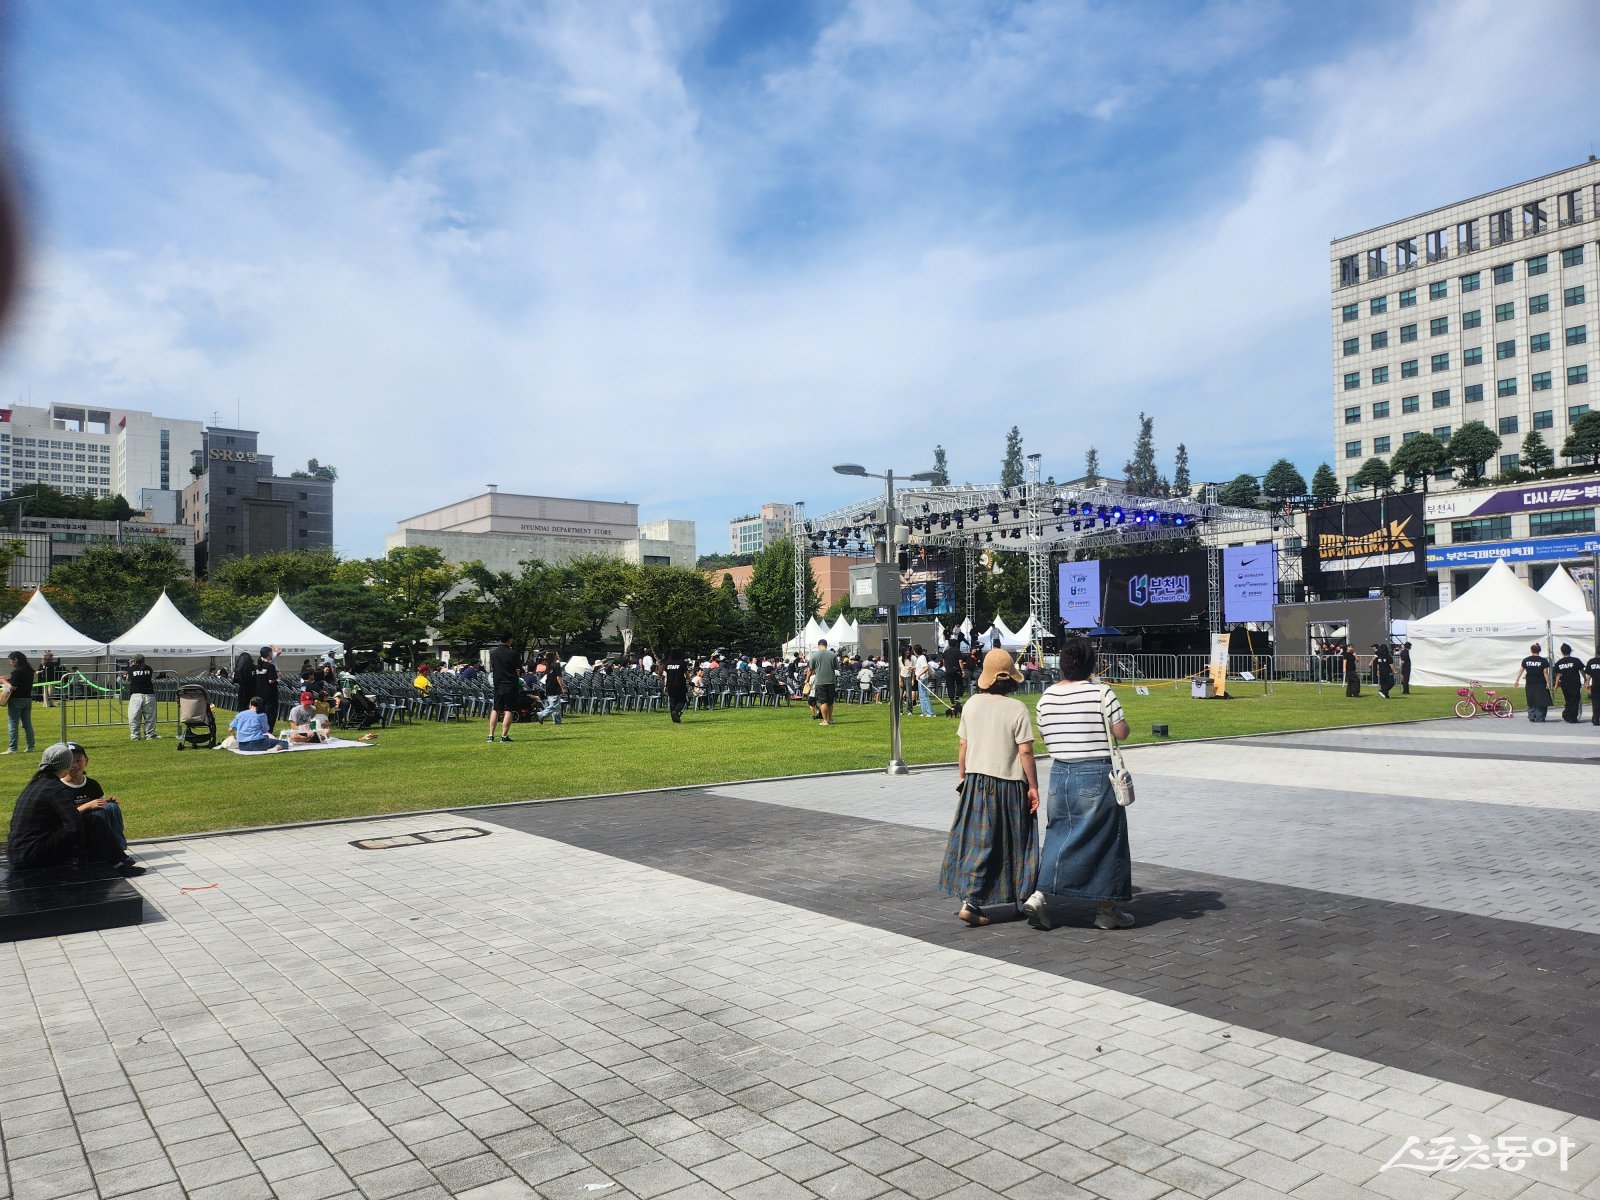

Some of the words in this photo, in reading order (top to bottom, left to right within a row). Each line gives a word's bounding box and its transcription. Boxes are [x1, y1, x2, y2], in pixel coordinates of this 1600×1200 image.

[1523, 491, 1548, 505] 다시
[1585, 485, 1600, 498] 부
[1427, 503, 1455, 514] 부천시
[521, 524, 549, 532] HYUNDAI
[552, 526, 591, 534] DEPARTMENT
[1446, 546, 1534, 561] 부천국제만화축제
[1150, 576, 1189, 594] 부천시
[1177, 594, 1189, 602] City
